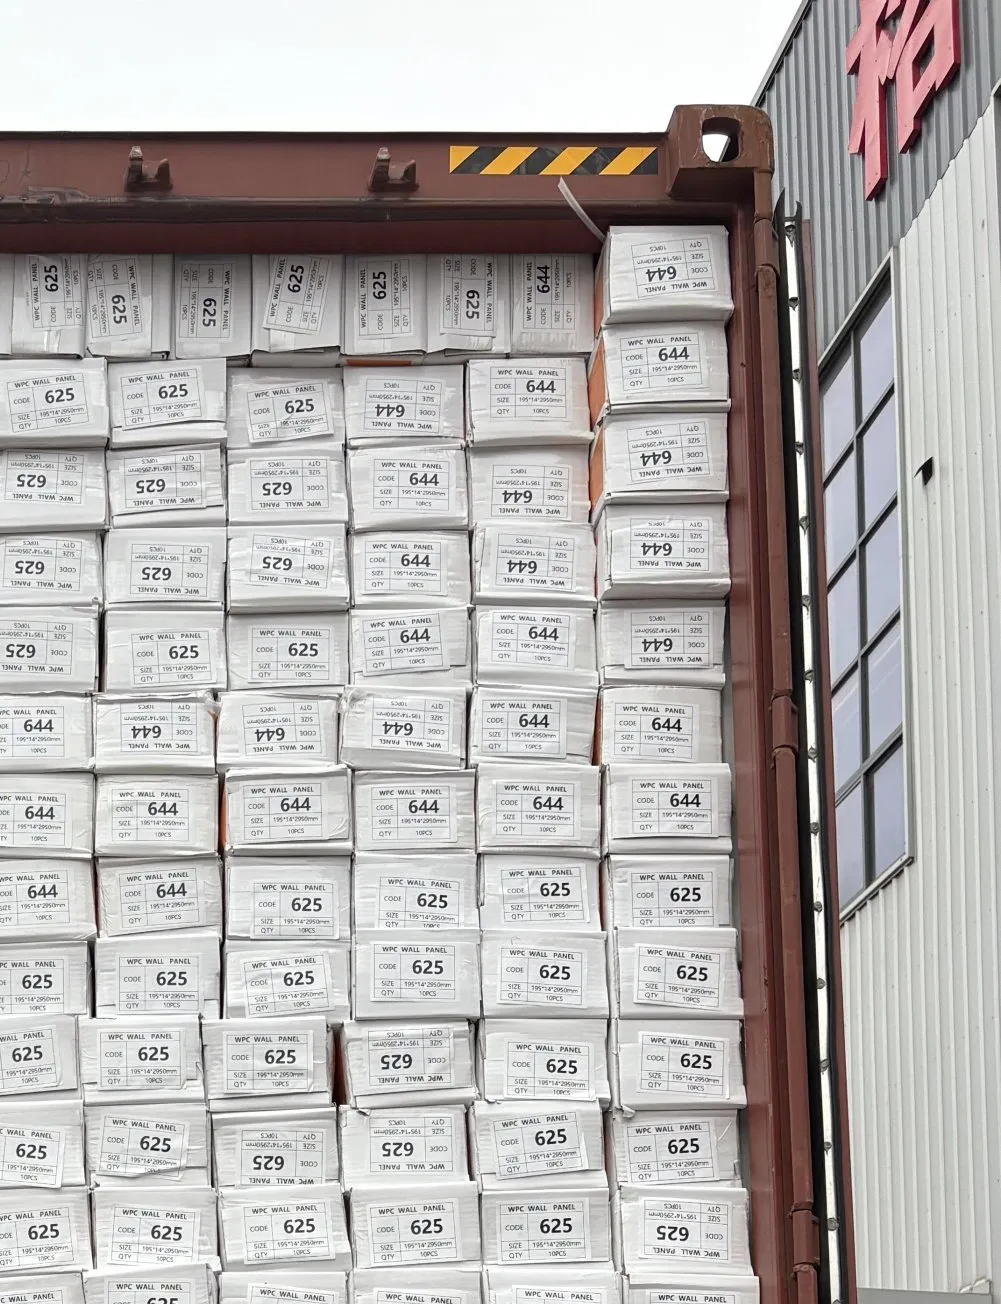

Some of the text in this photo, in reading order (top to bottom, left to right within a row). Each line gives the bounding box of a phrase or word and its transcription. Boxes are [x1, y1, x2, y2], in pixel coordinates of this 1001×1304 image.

[373, 272, 386, 299] 625
[627, 339, 643, 347] WPC
[659, 347, 689, 361] 644
[158, 384, 188, 399] 625
[640, 450, 672, 466] 644
[400, 628, 431, 643] 644
[670, 793, 701, 807] 644
[670, 887, 701, 902] 625
[412, 960, 443, 974] 625
[681, 1053, 712, 1070] 625
[382, 1142, 414, 1157] 625
[658, 1294, 675, 1302] WPC
